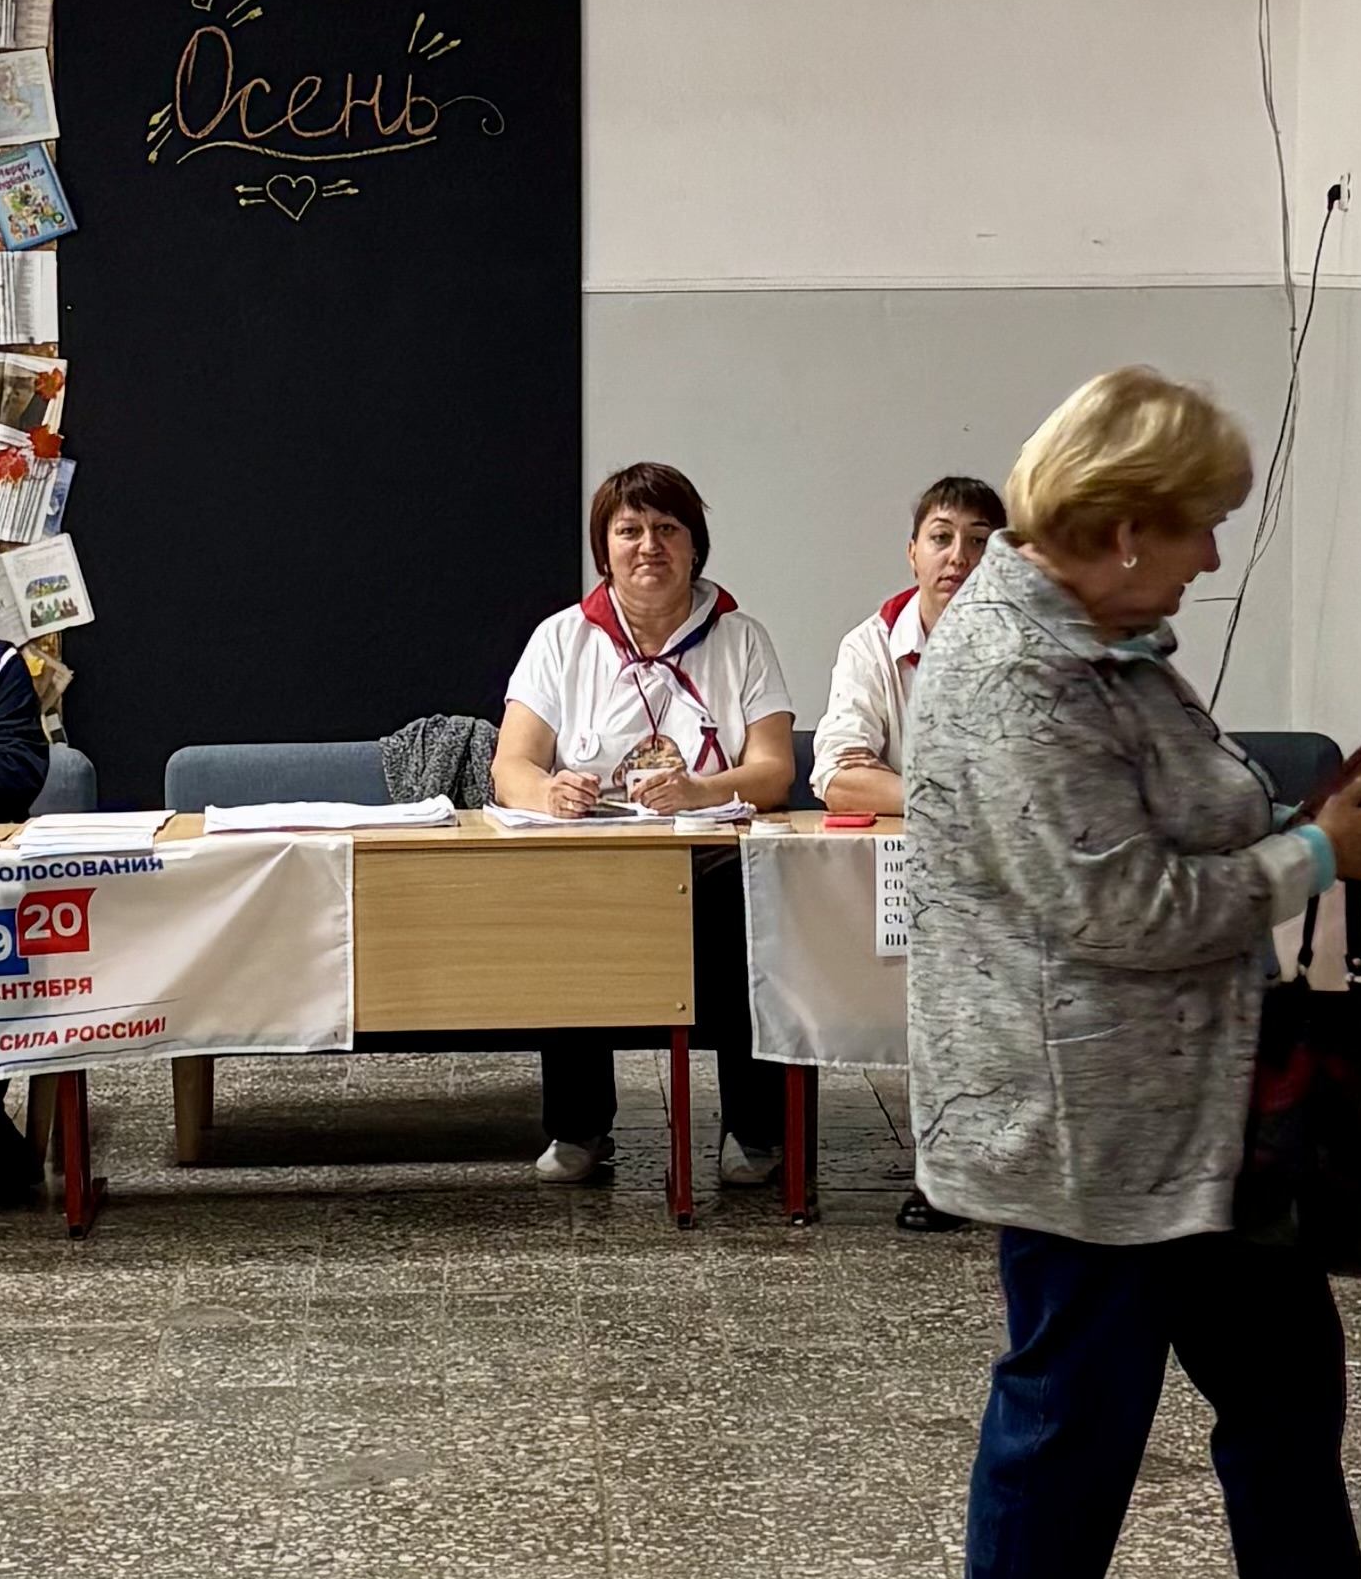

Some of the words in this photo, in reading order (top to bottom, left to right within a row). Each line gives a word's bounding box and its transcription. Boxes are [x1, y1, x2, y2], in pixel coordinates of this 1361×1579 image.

[175, 25, 439, 140] Осень
[22, 901, 83, 941] 20
[64, 1016, 167, 1046] РОССИИ!
